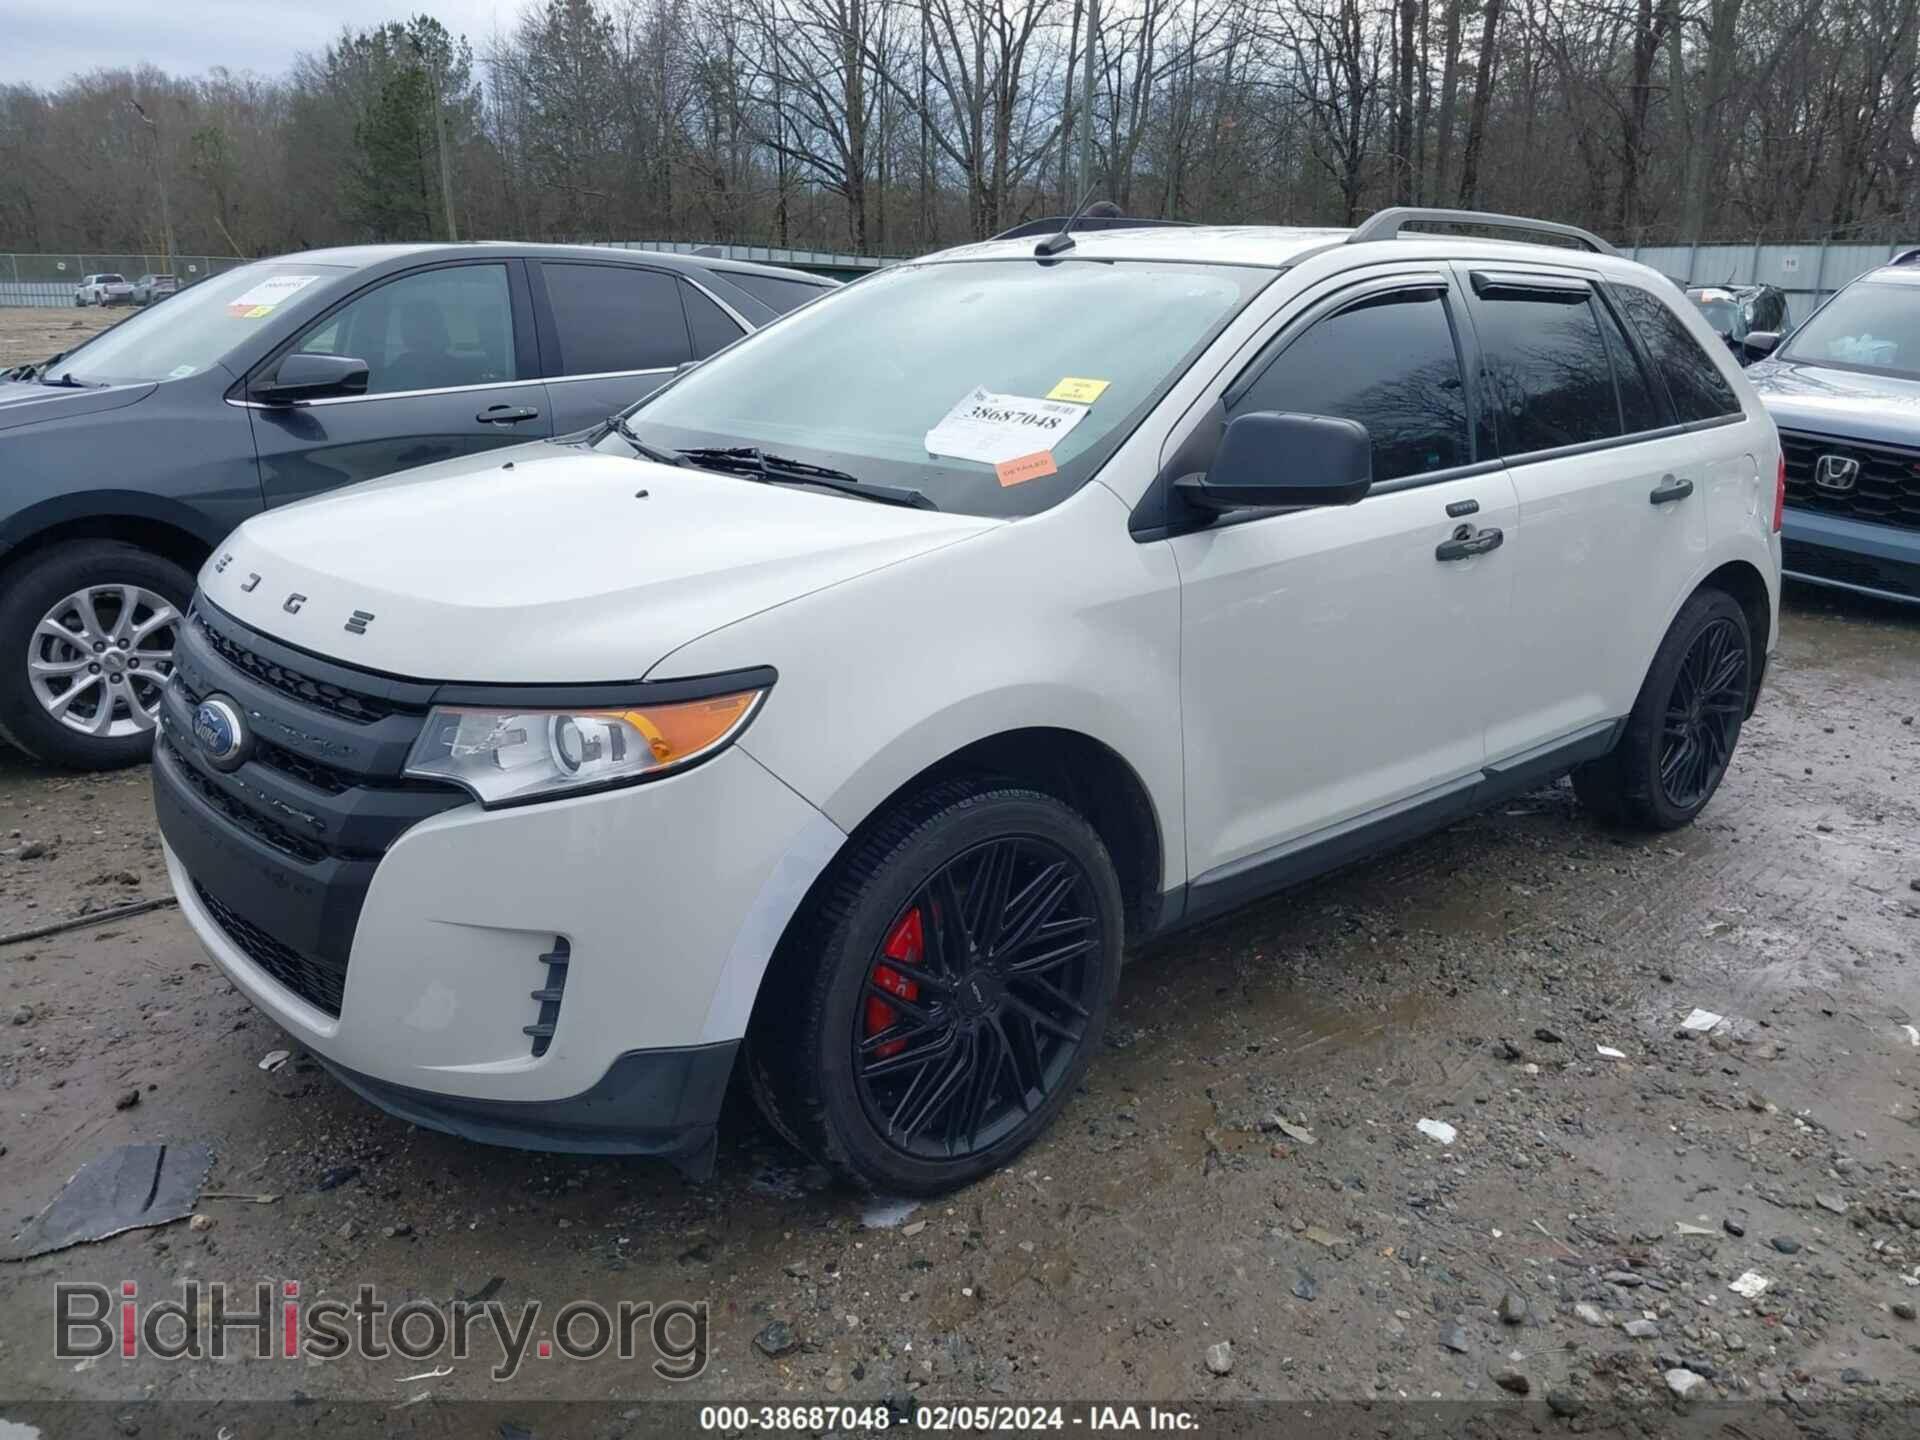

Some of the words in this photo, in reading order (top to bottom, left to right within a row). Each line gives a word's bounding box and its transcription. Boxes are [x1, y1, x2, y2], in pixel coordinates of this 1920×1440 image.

[963, 405, 1062, 430] 38687048
[1002, 459, 1049, 477] DETAILED
[194, 705, 223, 748] Ford
